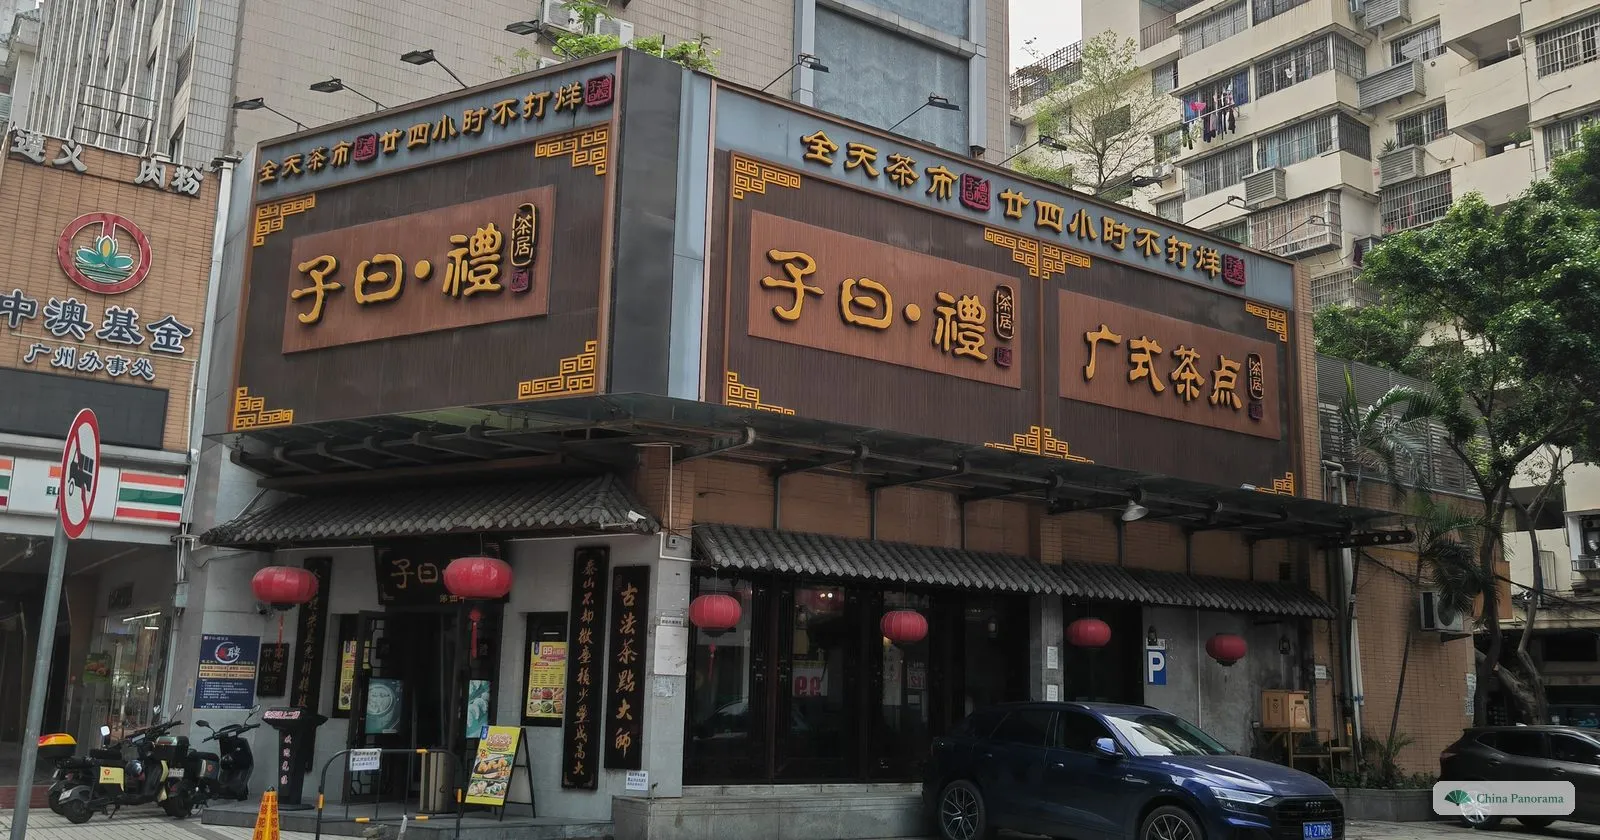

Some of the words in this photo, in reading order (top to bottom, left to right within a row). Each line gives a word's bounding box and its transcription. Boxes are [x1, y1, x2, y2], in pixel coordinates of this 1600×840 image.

[257, 139, 355, 185] 全天茶市
[379, 81, 585, 155] 廿四小时不打烊
[11, 129, 88, 172] 遵义
[134, 157, 204, 195] 肉粉
[801, 129, 959, 200] 全天茶市
[999, 187, 1222, 280] 廿四小时不打烊
[514, 214, 532, 258] 茶居
[0, 288, 193, 354] 中澳基金
[998, 294, 1012, 330] 茶居
[23, 343, 156, 381] 广州办事处
[1084, 324, 1243, 410] 广式茶点
[1251, 360, 1262, 392] 茶居
[1148, 651, 1165, 683] P
